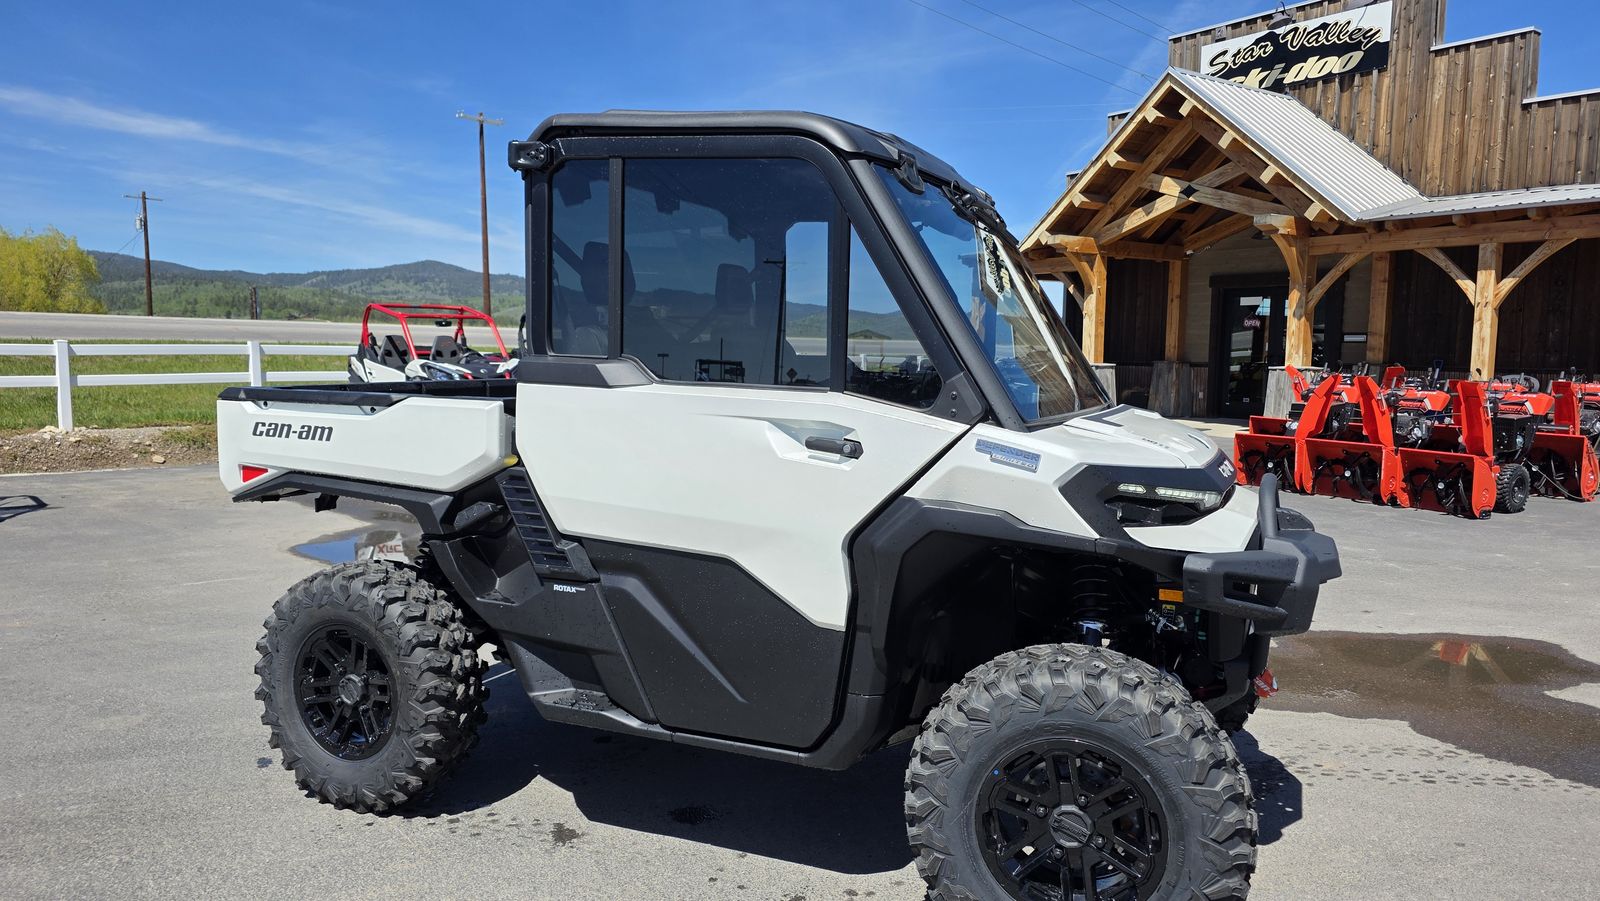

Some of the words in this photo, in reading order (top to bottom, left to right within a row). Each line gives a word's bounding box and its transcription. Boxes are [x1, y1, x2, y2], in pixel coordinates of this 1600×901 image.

[1208, 41, 1274, 77] Star
[1280, 18, 1383, 51] Valley
[1243, 319, 1261, 328] OPEN
[252, 421, 334, 442] can-am
[975, 439, 1041, 463] DEFENDER
[553, 584, 577, 594] ROTAX
